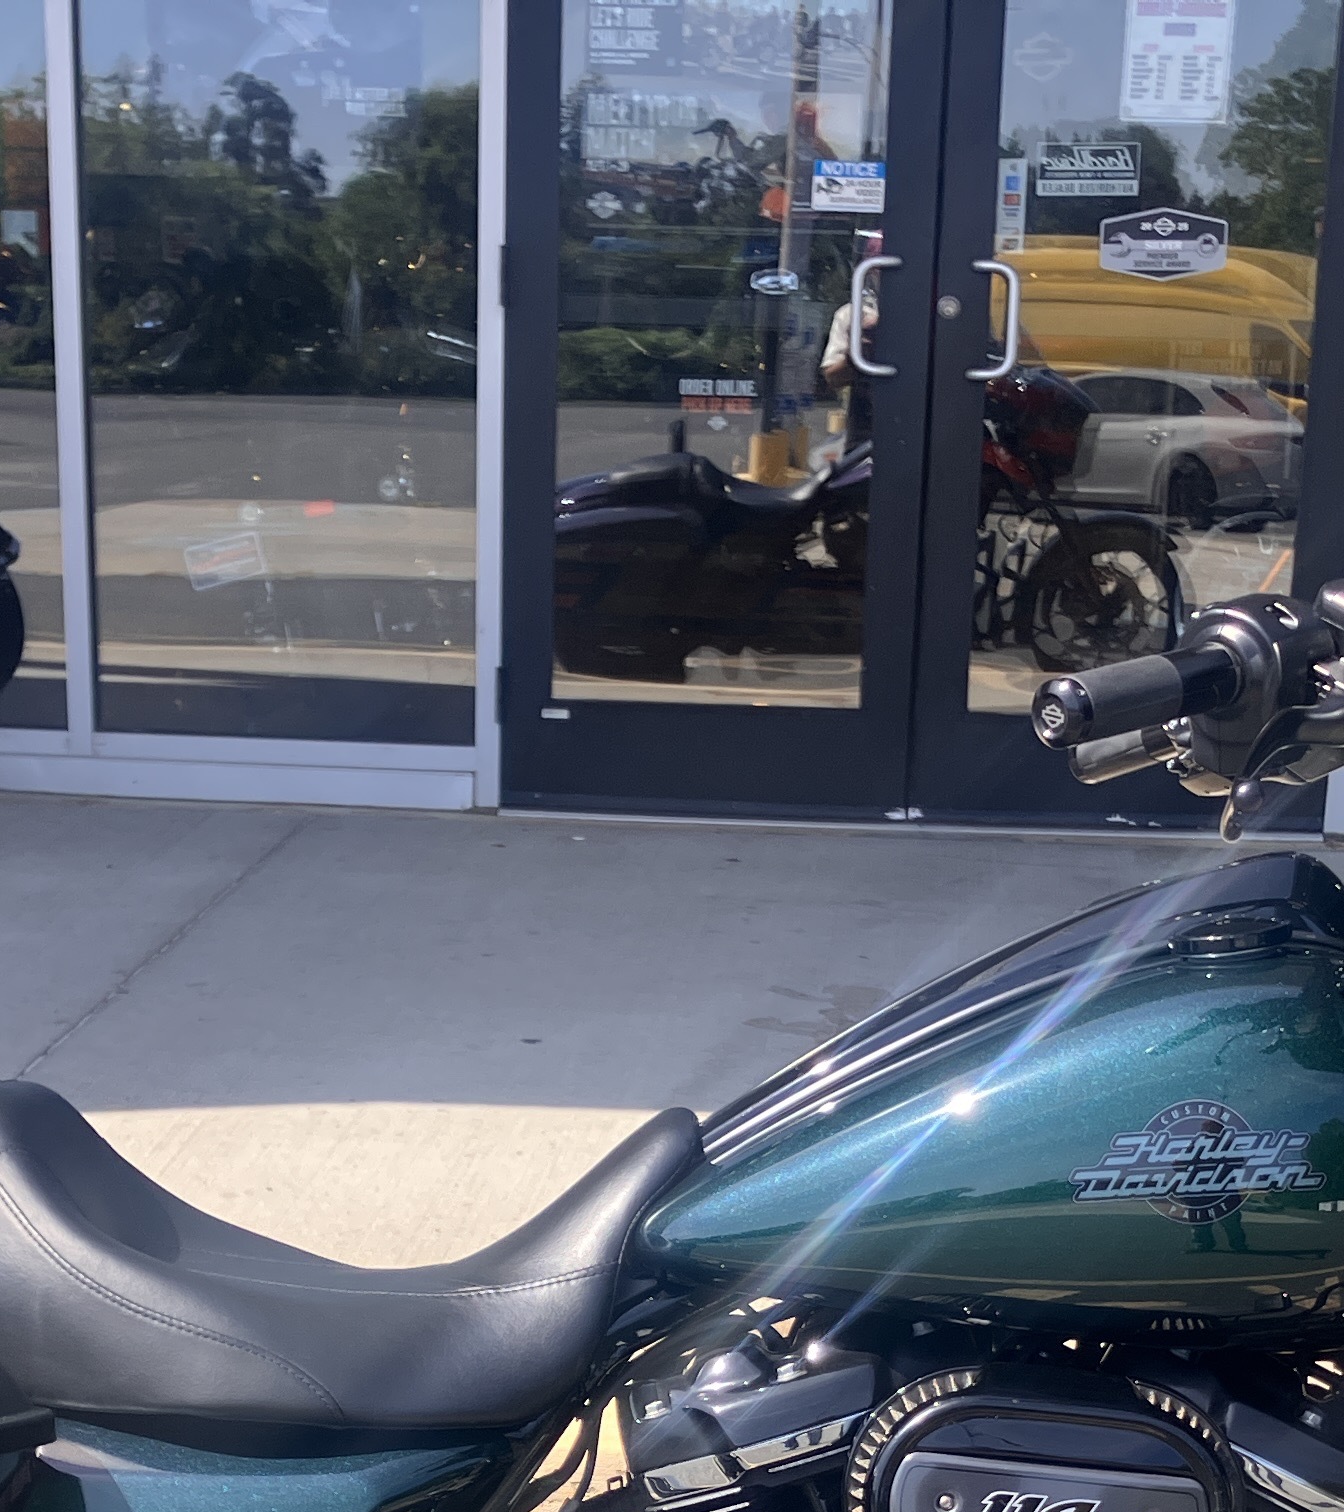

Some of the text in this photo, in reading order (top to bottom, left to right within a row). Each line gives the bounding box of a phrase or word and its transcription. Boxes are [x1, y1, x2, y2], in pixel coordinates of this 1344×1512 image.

[821, 161, 879, 176] NOTICE
[1160, 1103, 1231, 1125] CUSTOM
[1167, 1201, 1228, 1220] PAINT
